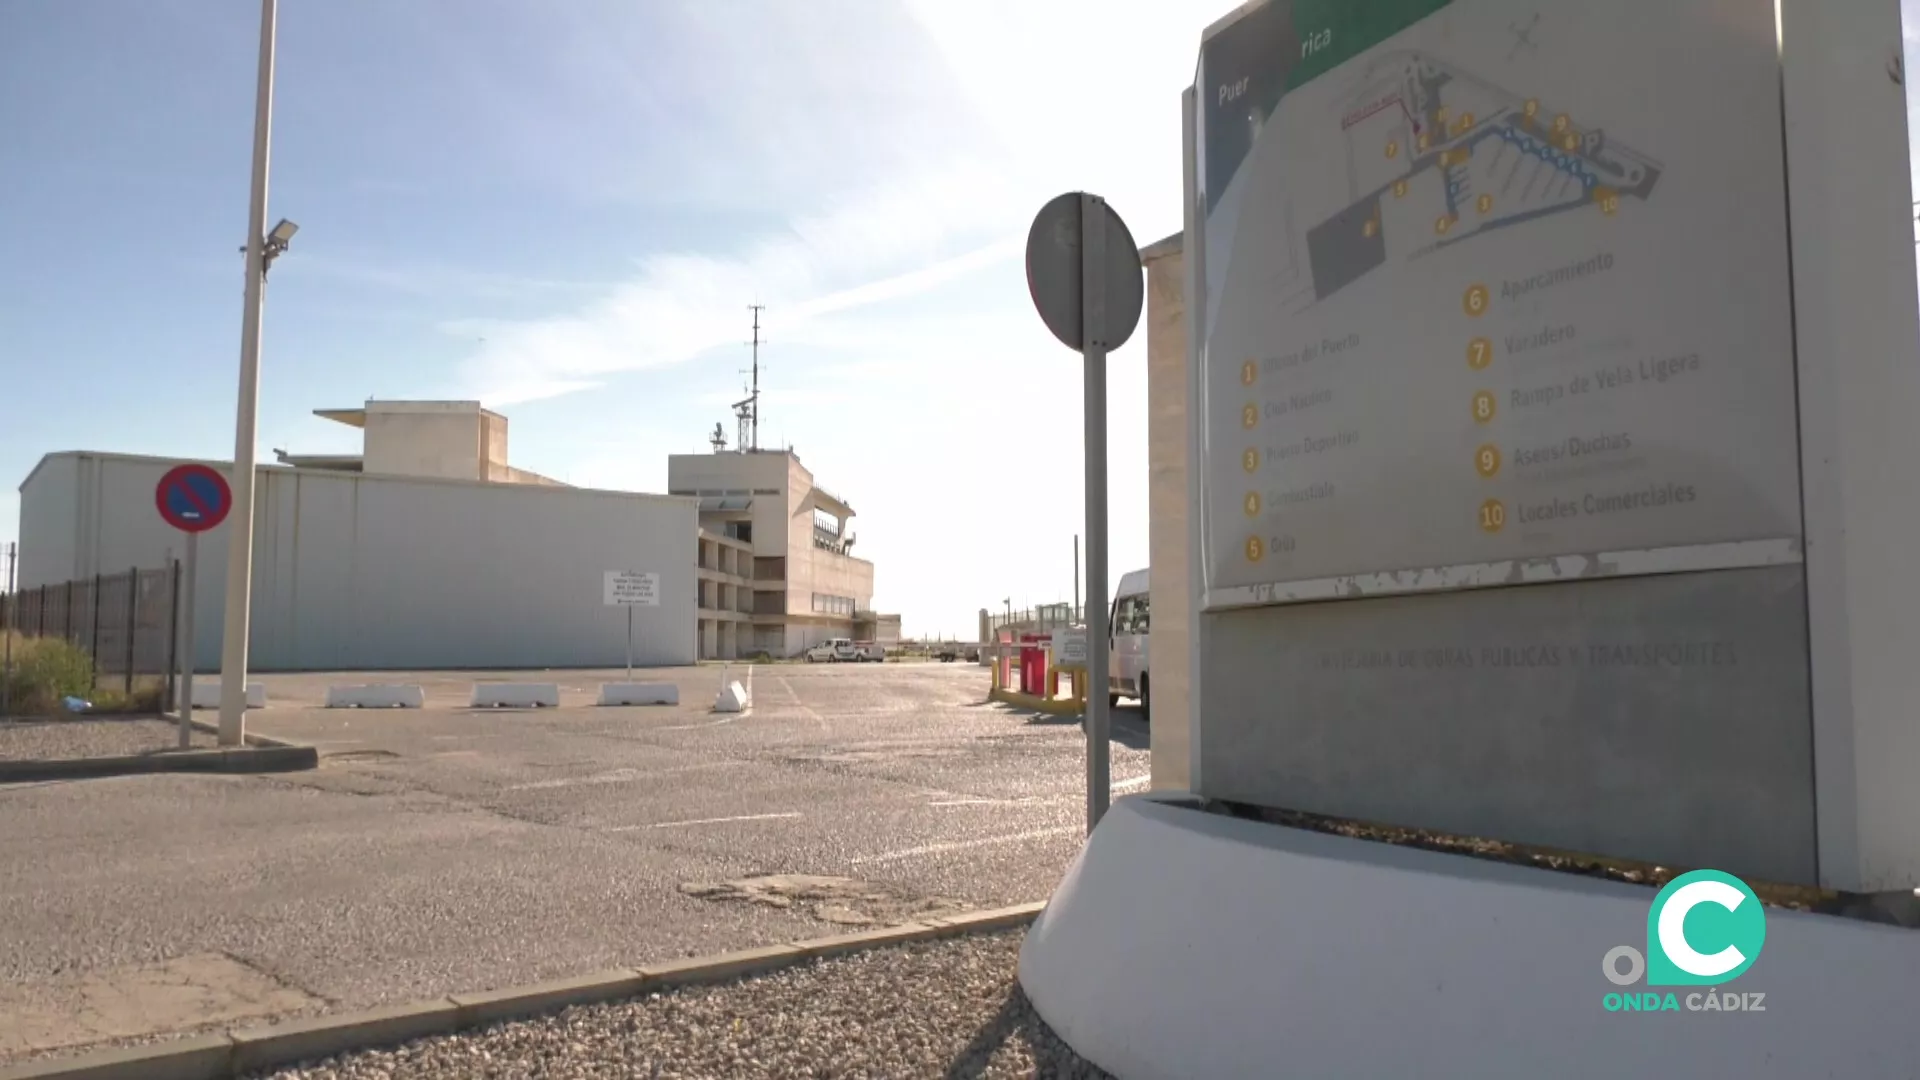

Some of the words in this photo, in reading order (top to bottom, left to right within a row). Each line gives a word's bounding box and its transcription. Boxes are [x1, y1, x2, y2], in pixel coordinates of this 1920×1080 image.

[1301, 27, 1332, 59] rica
[1469, 289, 1482, 311] 6
[1501, 251, 1614, 301] Aparcamiento
[1473, 342, 1485, 364] 7
[1504, 323, 1576, 355] Varadero
[1478, 396, 1490, 418] 8
[1569, 375, 1590, 396] de
[1482, 450, 1494, 472] 9
[1482, 503, 1504, 527] 10
[1518, 497, 1578, 524] Locales
[1583, 482, 1698, 516] Comerciales
